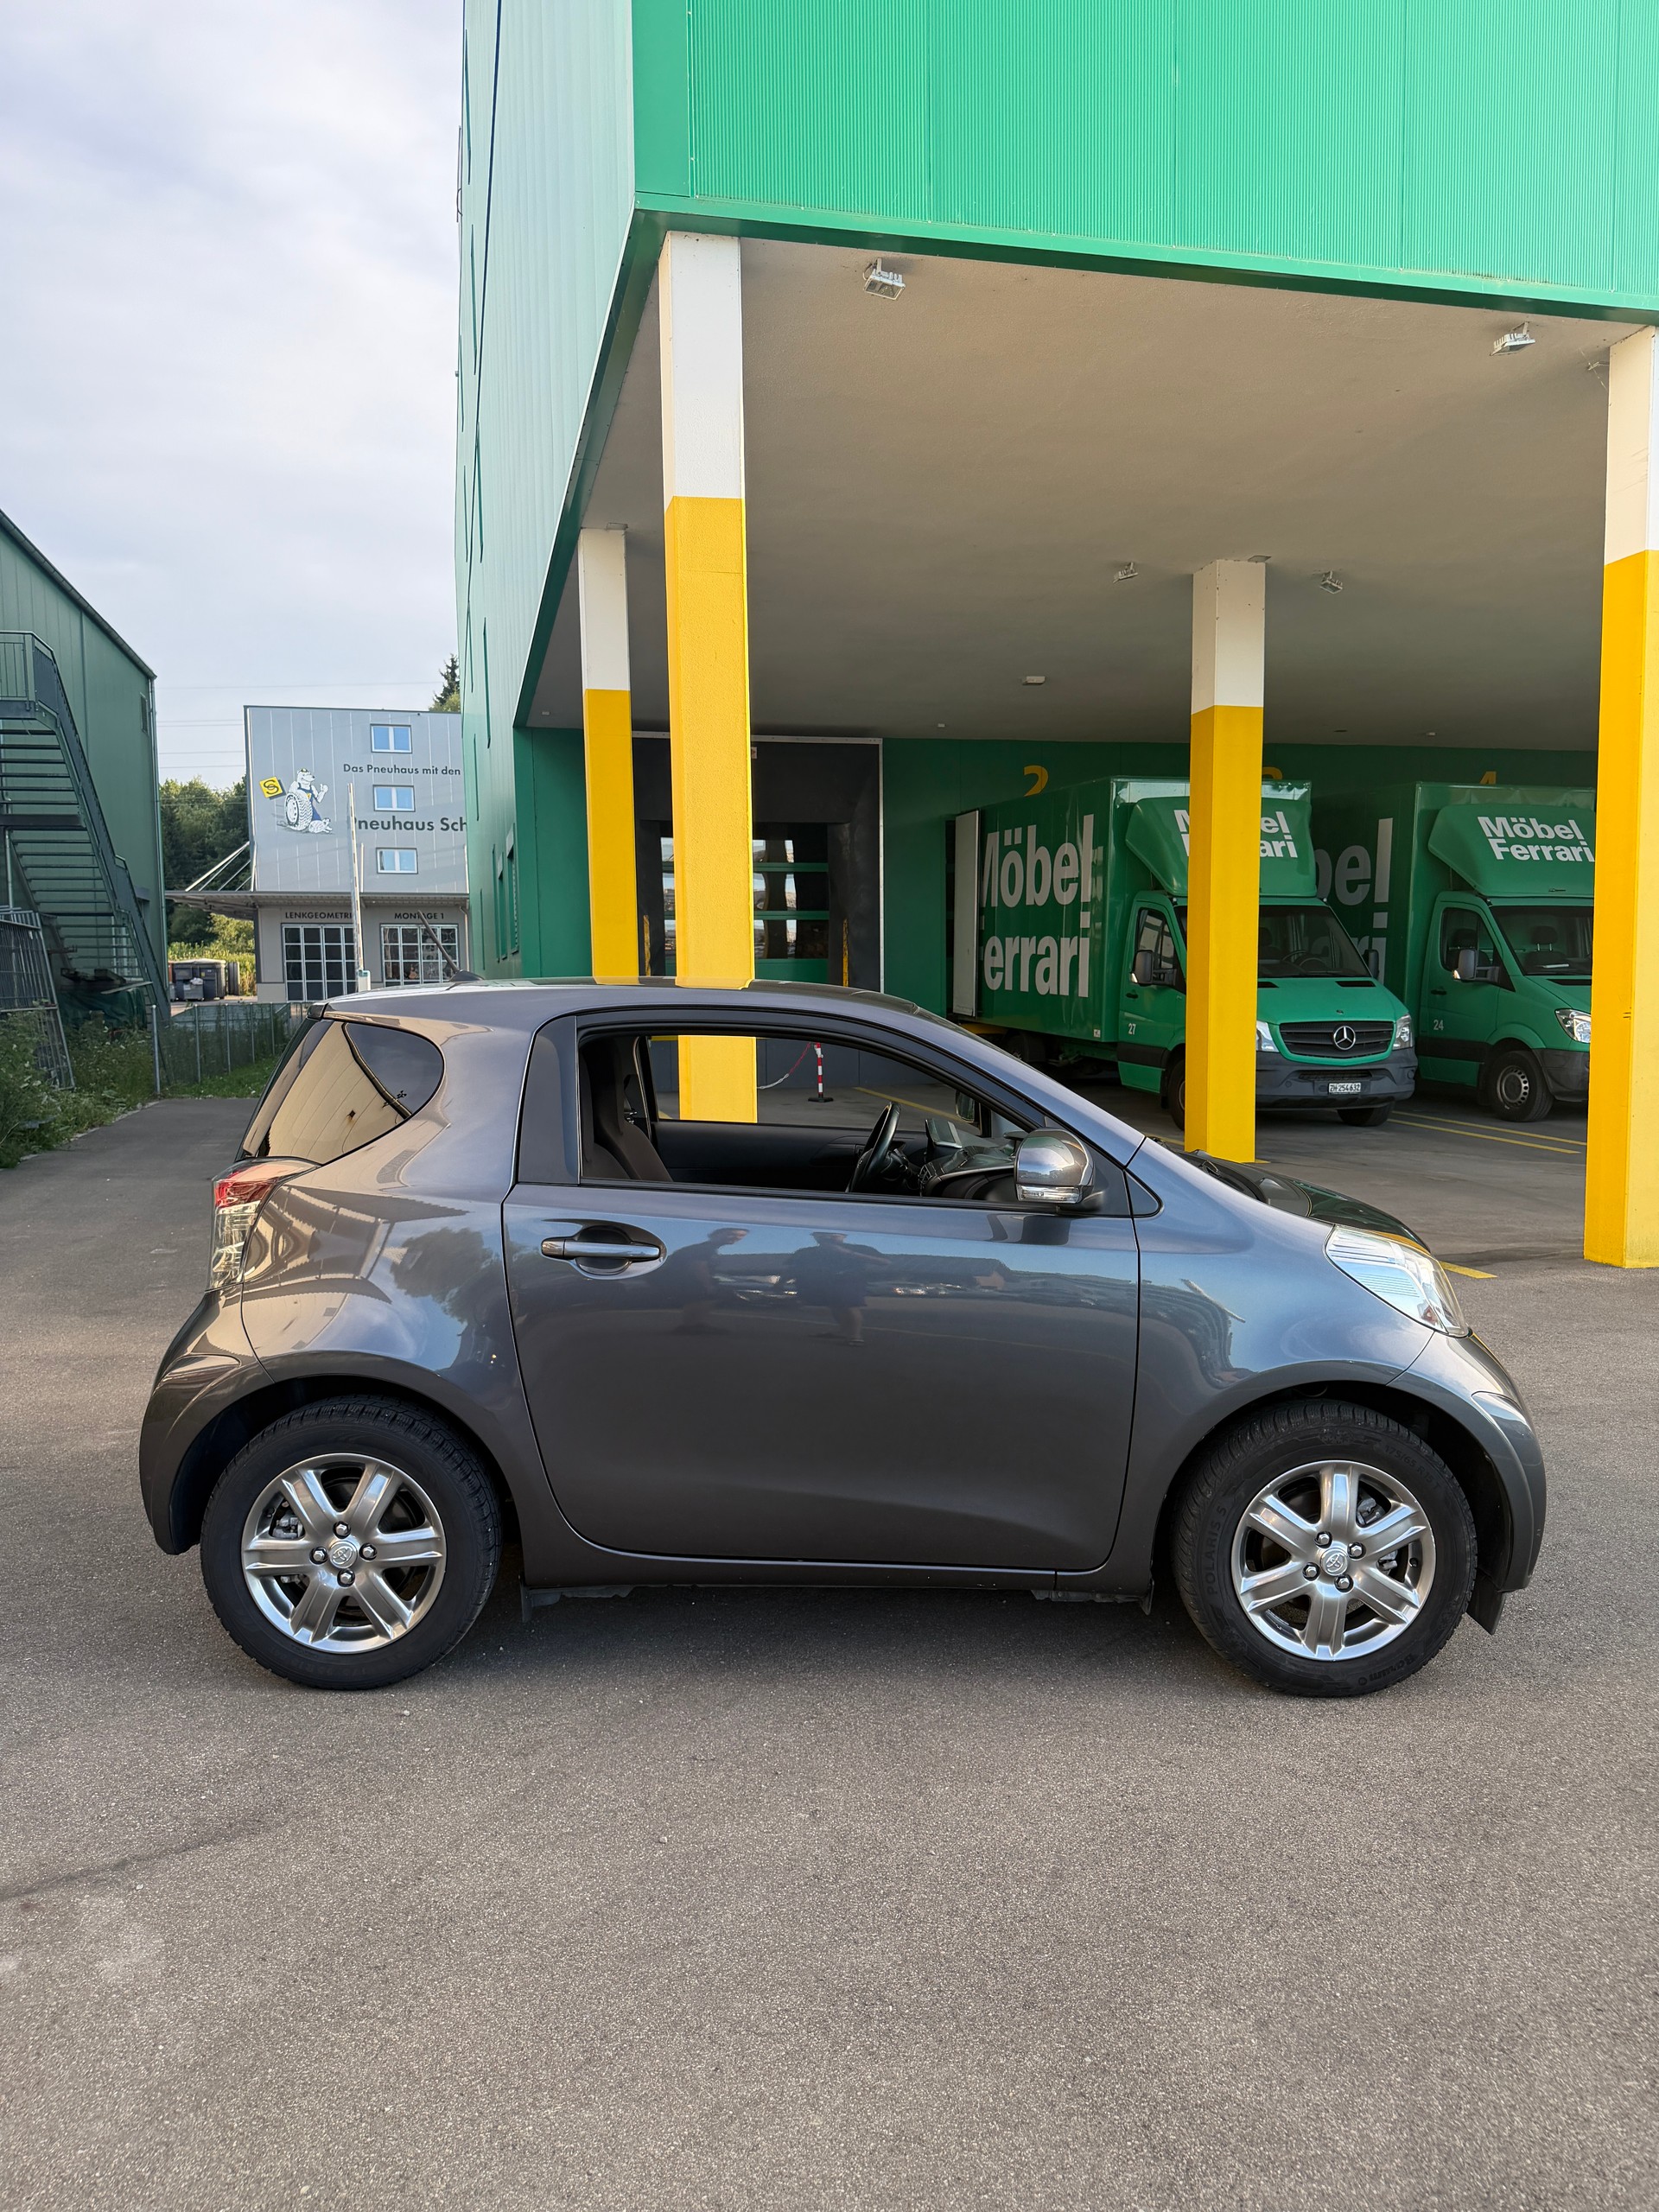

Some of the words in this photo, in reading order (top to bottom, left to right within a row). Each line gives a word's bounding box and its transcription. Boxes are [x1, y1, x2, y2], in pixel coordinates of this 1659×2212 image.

[343, 764, 364, 772] Das
[366, 765, 419, 774] Pneuhaus
[422, 766, 439, 775] mit
[441, 766, 461, 775] den
[353, 816, 435, 831] neuhaus
[1477, 817, 1585, 840] Möbel
[1488, 838, 1595, 862] Ferrari
[980, 912, 1091, 998] errari
[1128, 1022, 1136, 1035] 27
[1433, 1019, 1444, 1031] 24
[1205, 1521, 1221, 1595] POLARIS
